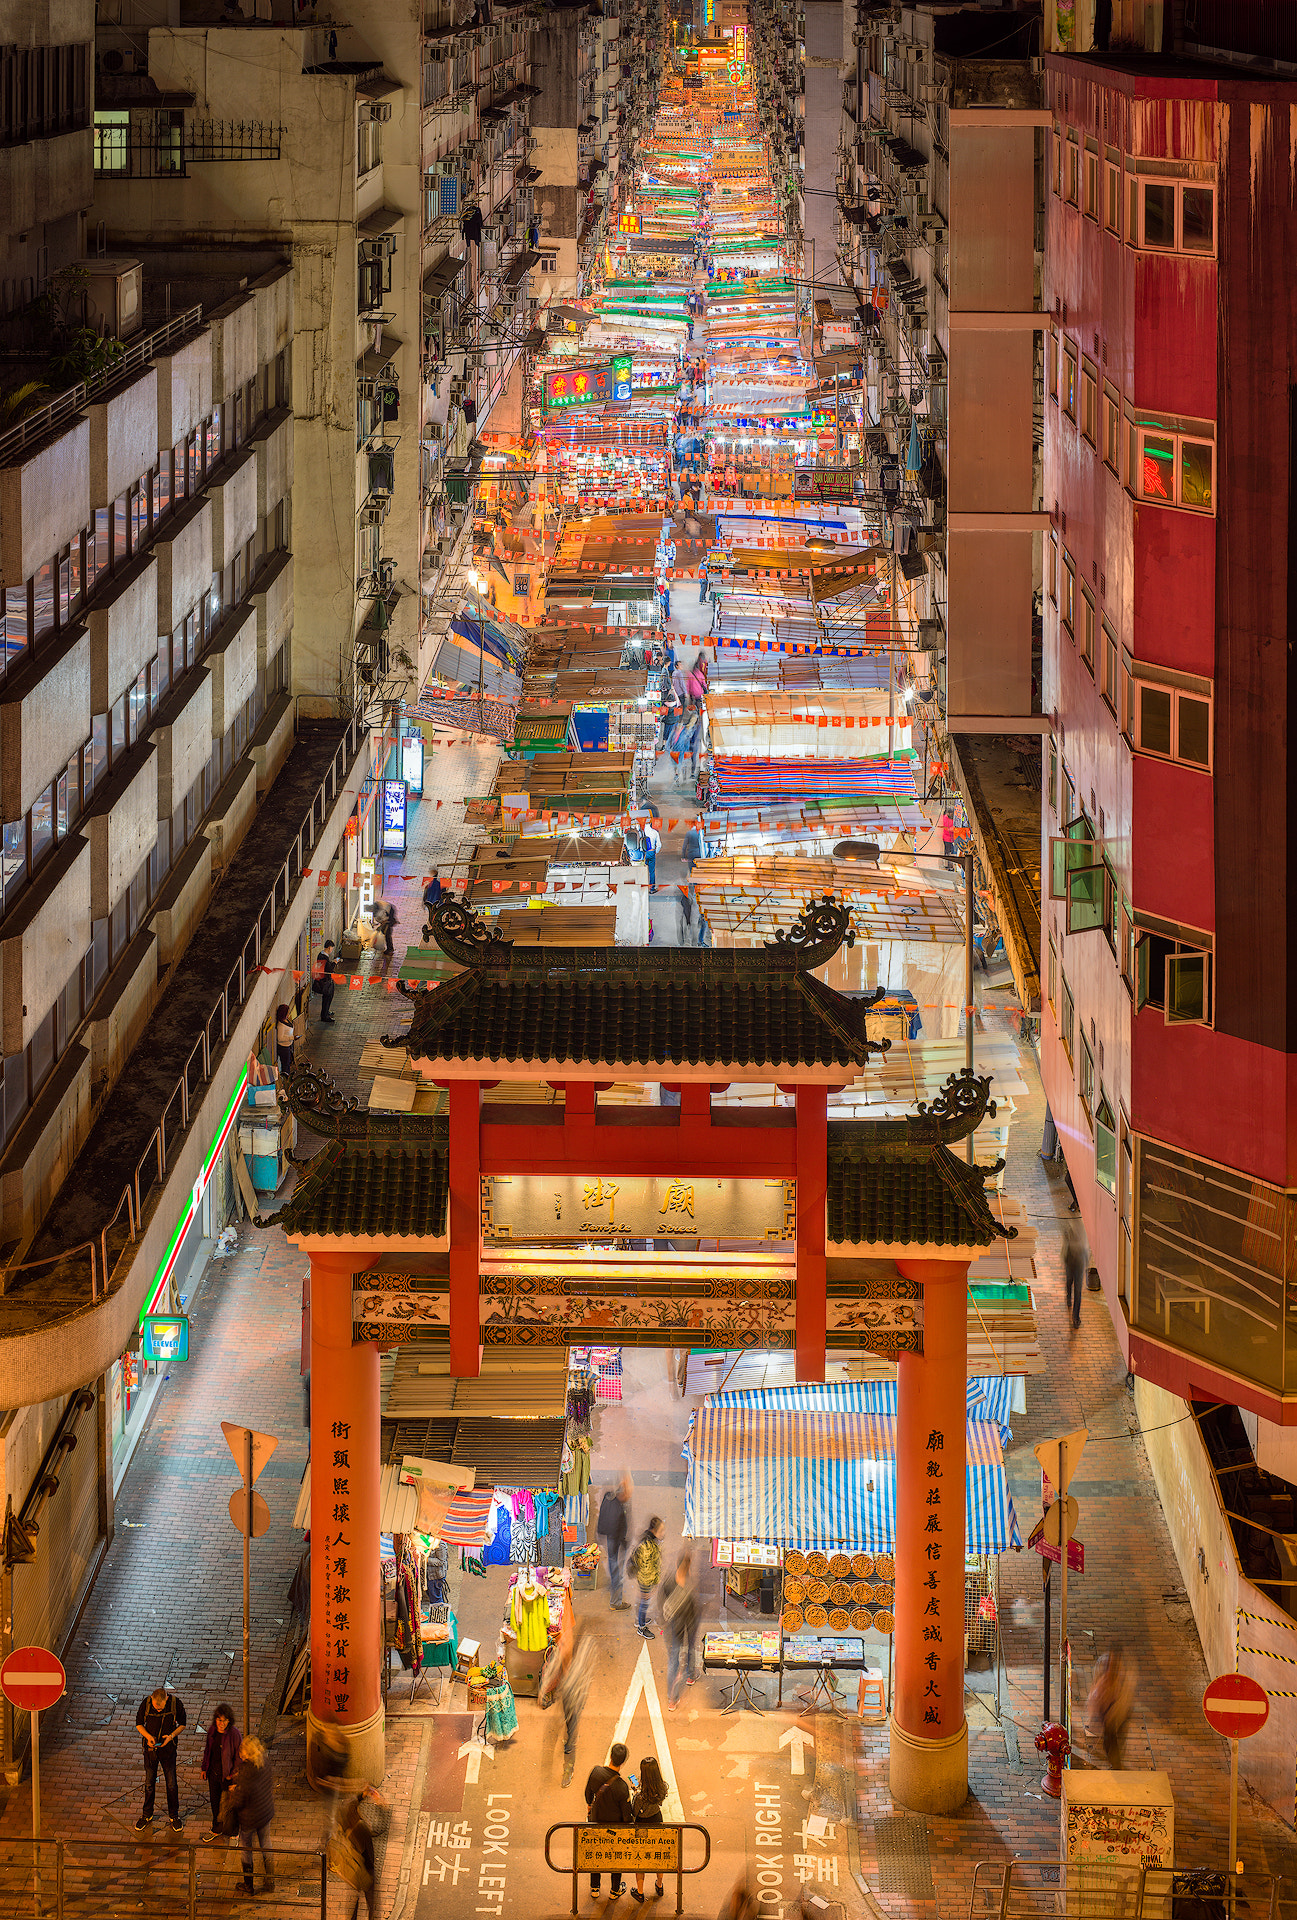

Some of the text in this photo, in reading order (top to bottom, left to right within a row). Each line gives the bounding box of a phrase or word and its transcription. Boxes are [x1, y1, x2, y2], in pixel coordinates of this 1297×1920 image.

[406, 727, 421, 738] 124
[579, 1221, 697, 1234] Temple Street
[154, 1325, 179, 1359] 7
[422, 1820, 473, 1886] 望左
[475, 1793, 513, 1915] LOOK LEFT
[581, 1836, 675, 1845] Part-time Pedestrian Area
[754, 1781, 784, 1920] LOOK RIGHT
